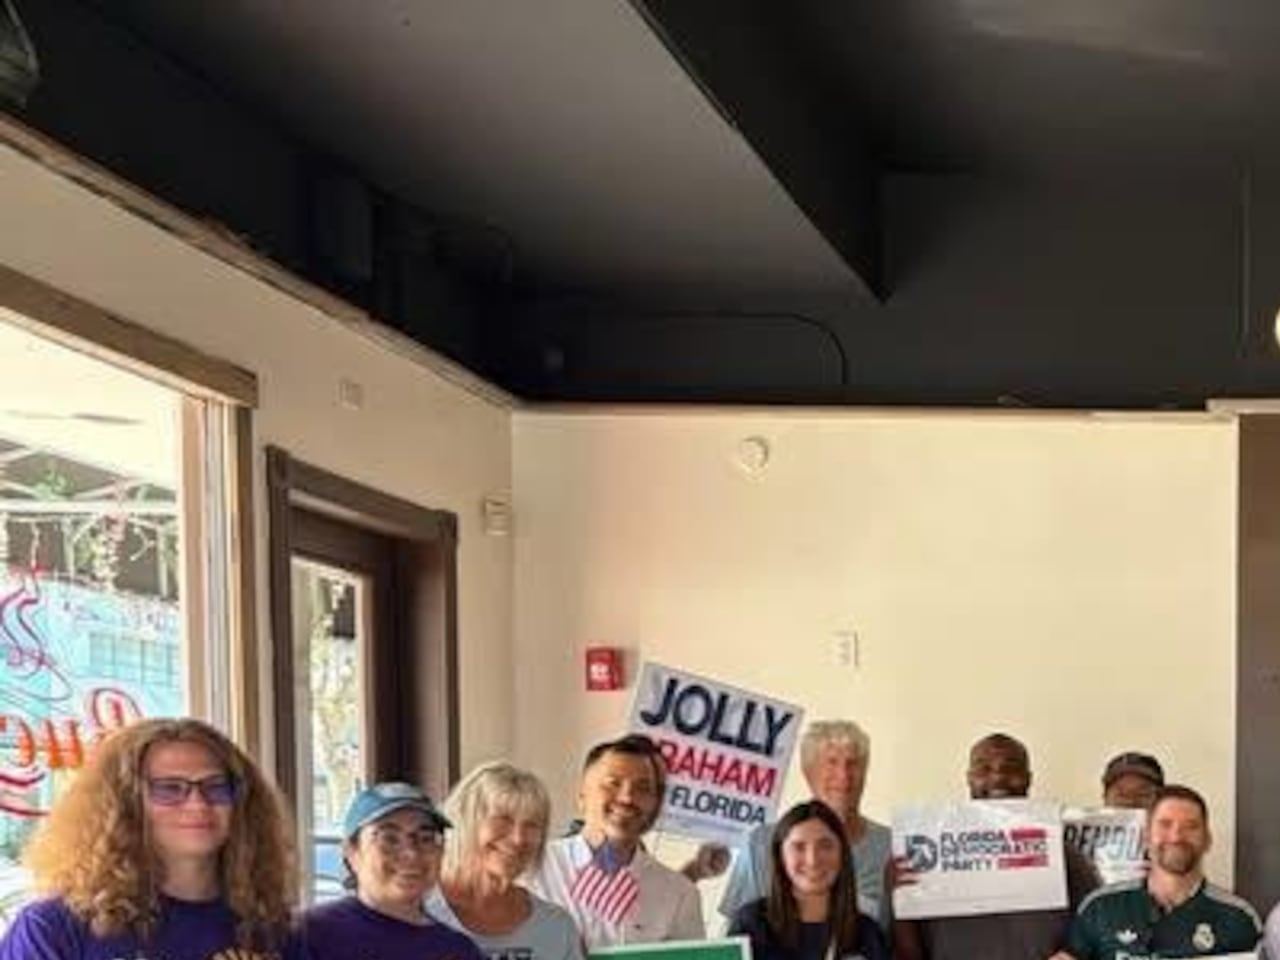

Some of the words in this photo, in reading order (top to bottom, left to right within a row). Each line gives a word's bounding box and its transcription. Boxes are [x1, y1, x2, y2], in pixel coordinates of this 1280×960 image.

[640, 677, 793, 757] JOLLY
[657, 739, 778, 797] RAHAM
[670, 787, 766, 825] FLORIDA
[941, 831, 1006, 843] FLORIDA
